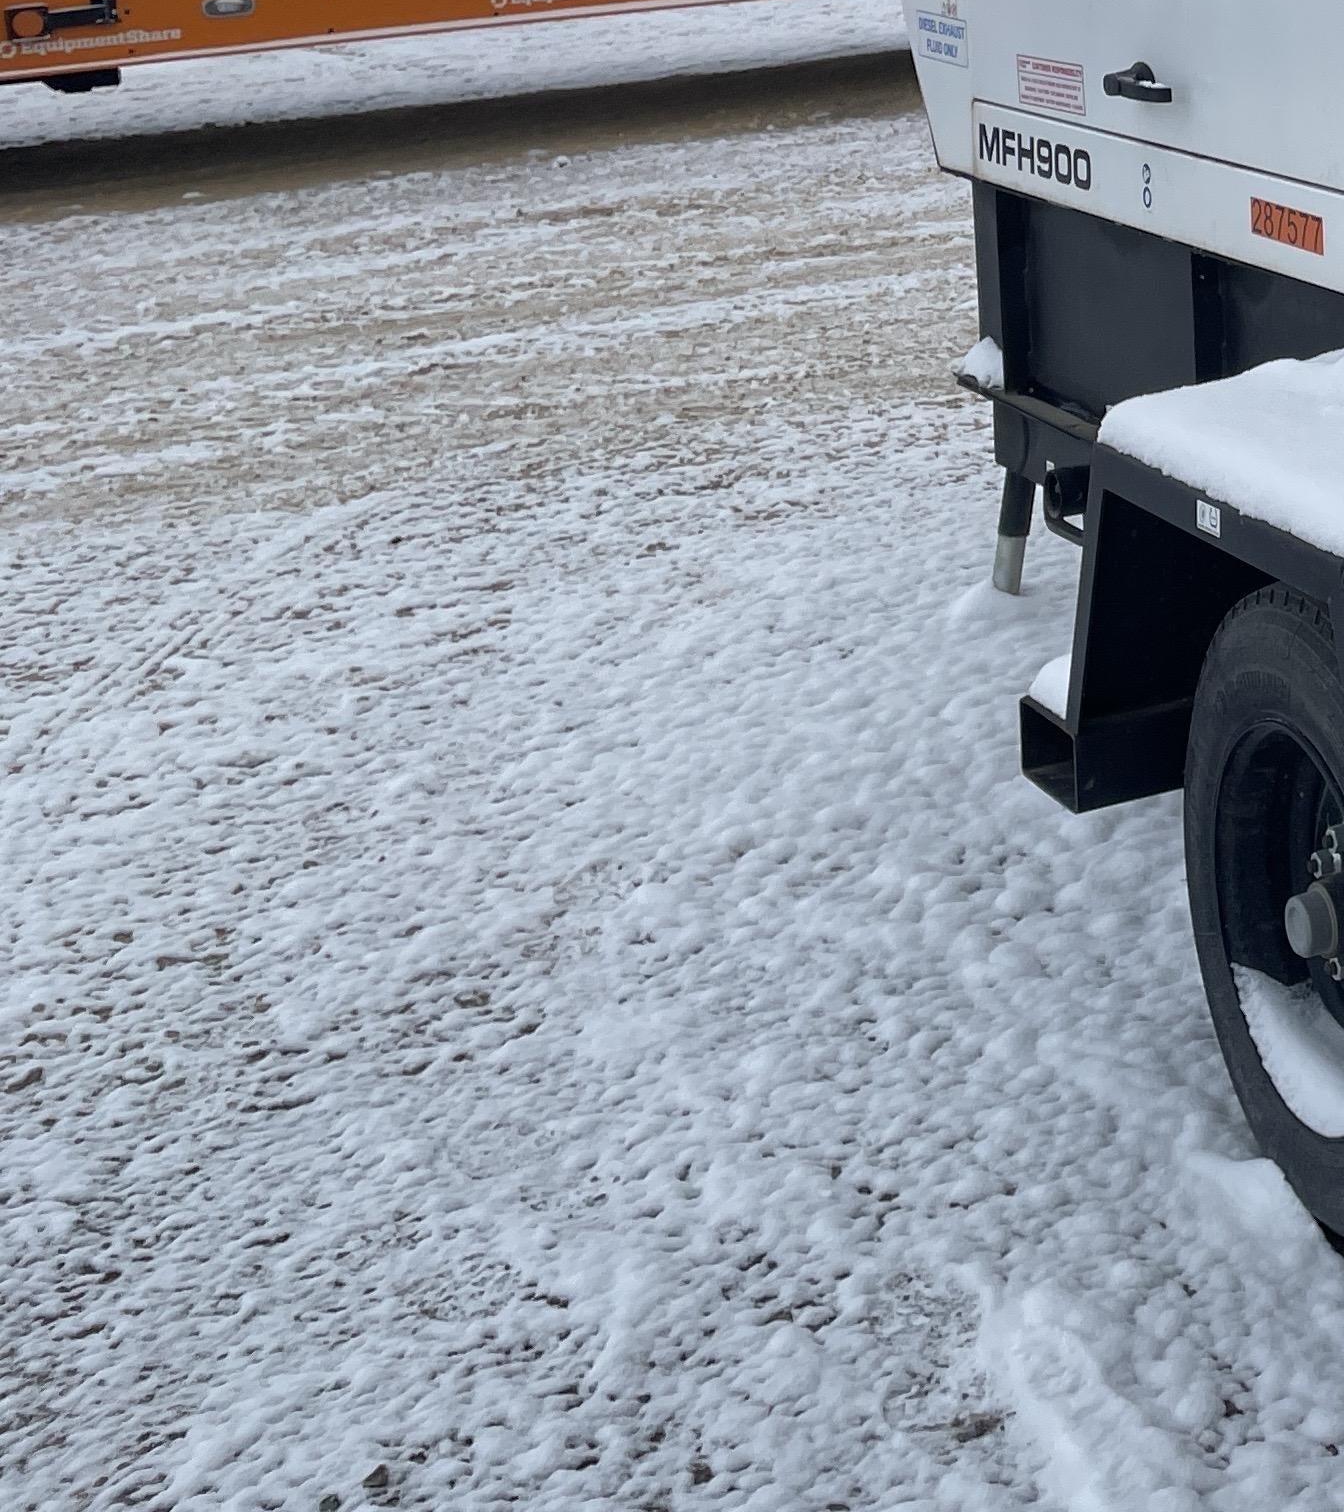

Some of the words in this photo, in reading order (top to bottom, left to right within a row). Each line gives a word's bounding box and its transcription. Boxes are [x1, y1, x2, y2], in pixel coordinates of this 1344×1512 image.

[20, 28, 182, 56] EquipmentShare
[918, 16, 938, 35] DIESEL
[938, 21, 965, 40] EXHAUST
[943, 42, 959, 59] ONLY
[978, 123, 1092, 191] MFH900
[1251, 197, 1324, 252] 287577
